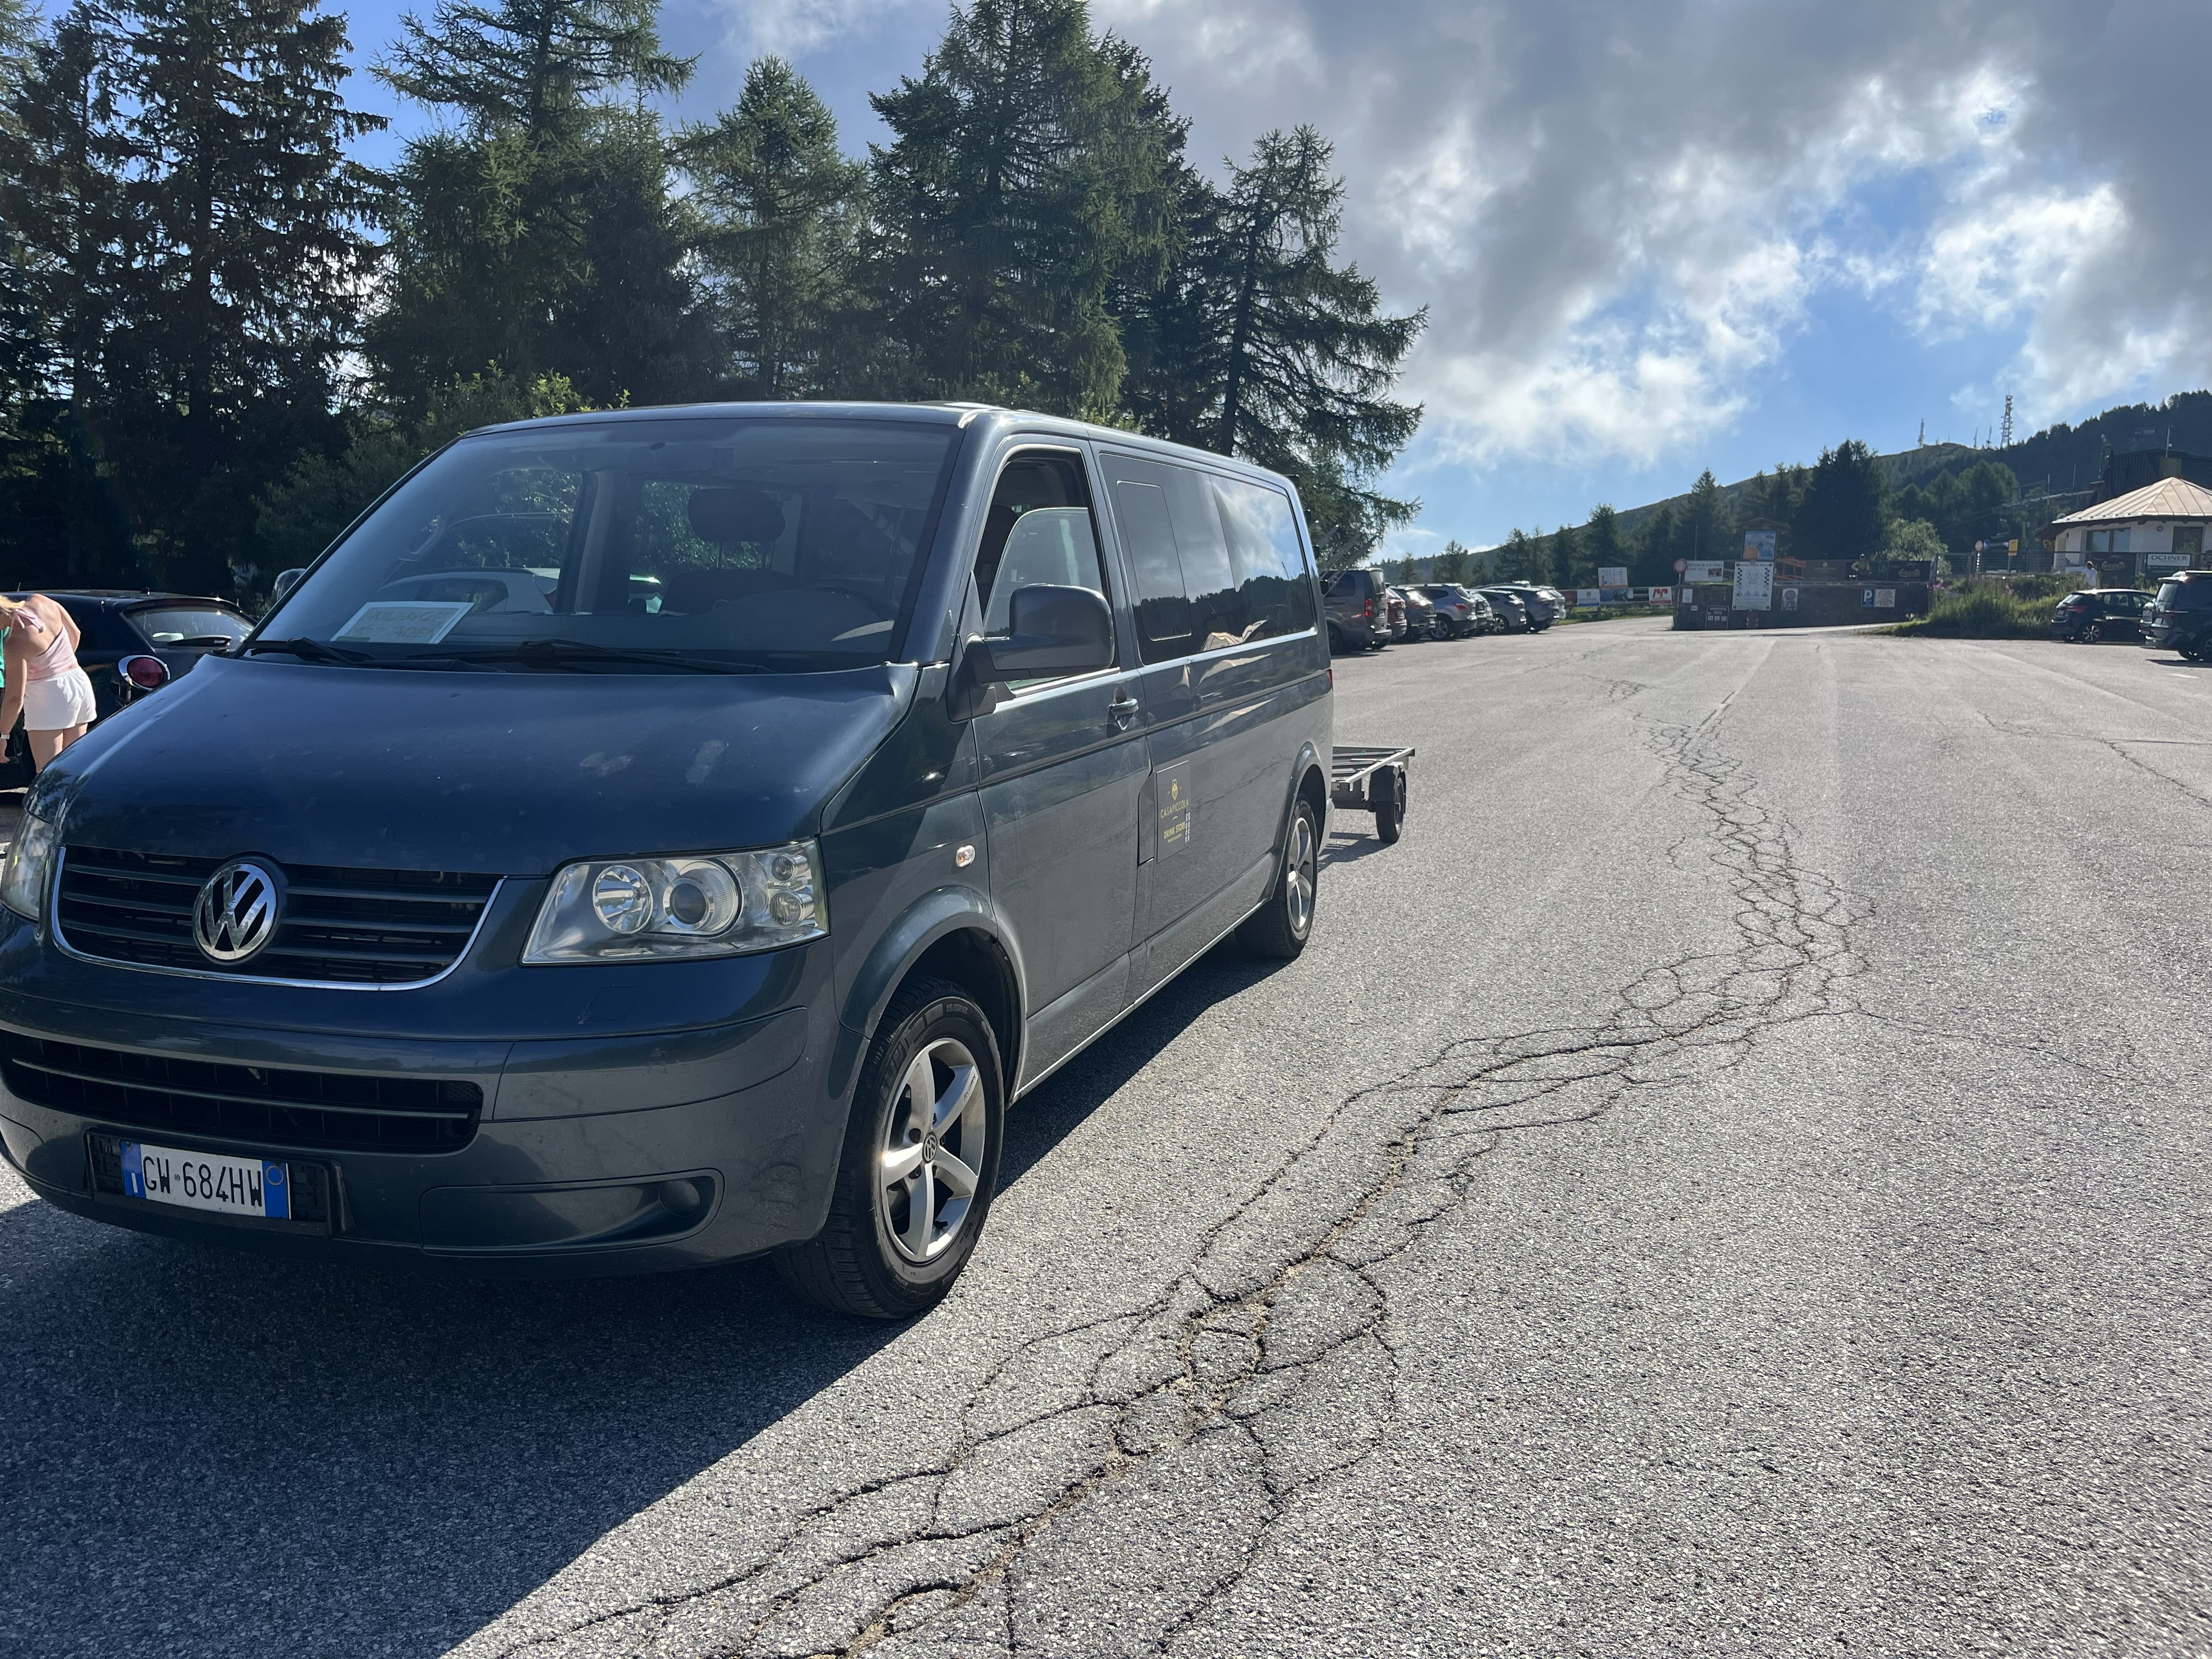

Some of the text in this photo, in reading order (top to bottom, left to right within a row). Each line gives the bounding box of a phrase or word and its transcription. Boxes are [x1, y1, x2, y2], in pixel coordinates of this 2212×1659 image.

[1864, 590, 1872, 602] P
[1160, 798, 1189, 818] CASAPICCOLA
[1164, 826, 1175, 839] DRINK
[143, 1156, 262, 1207] GW 684HW
